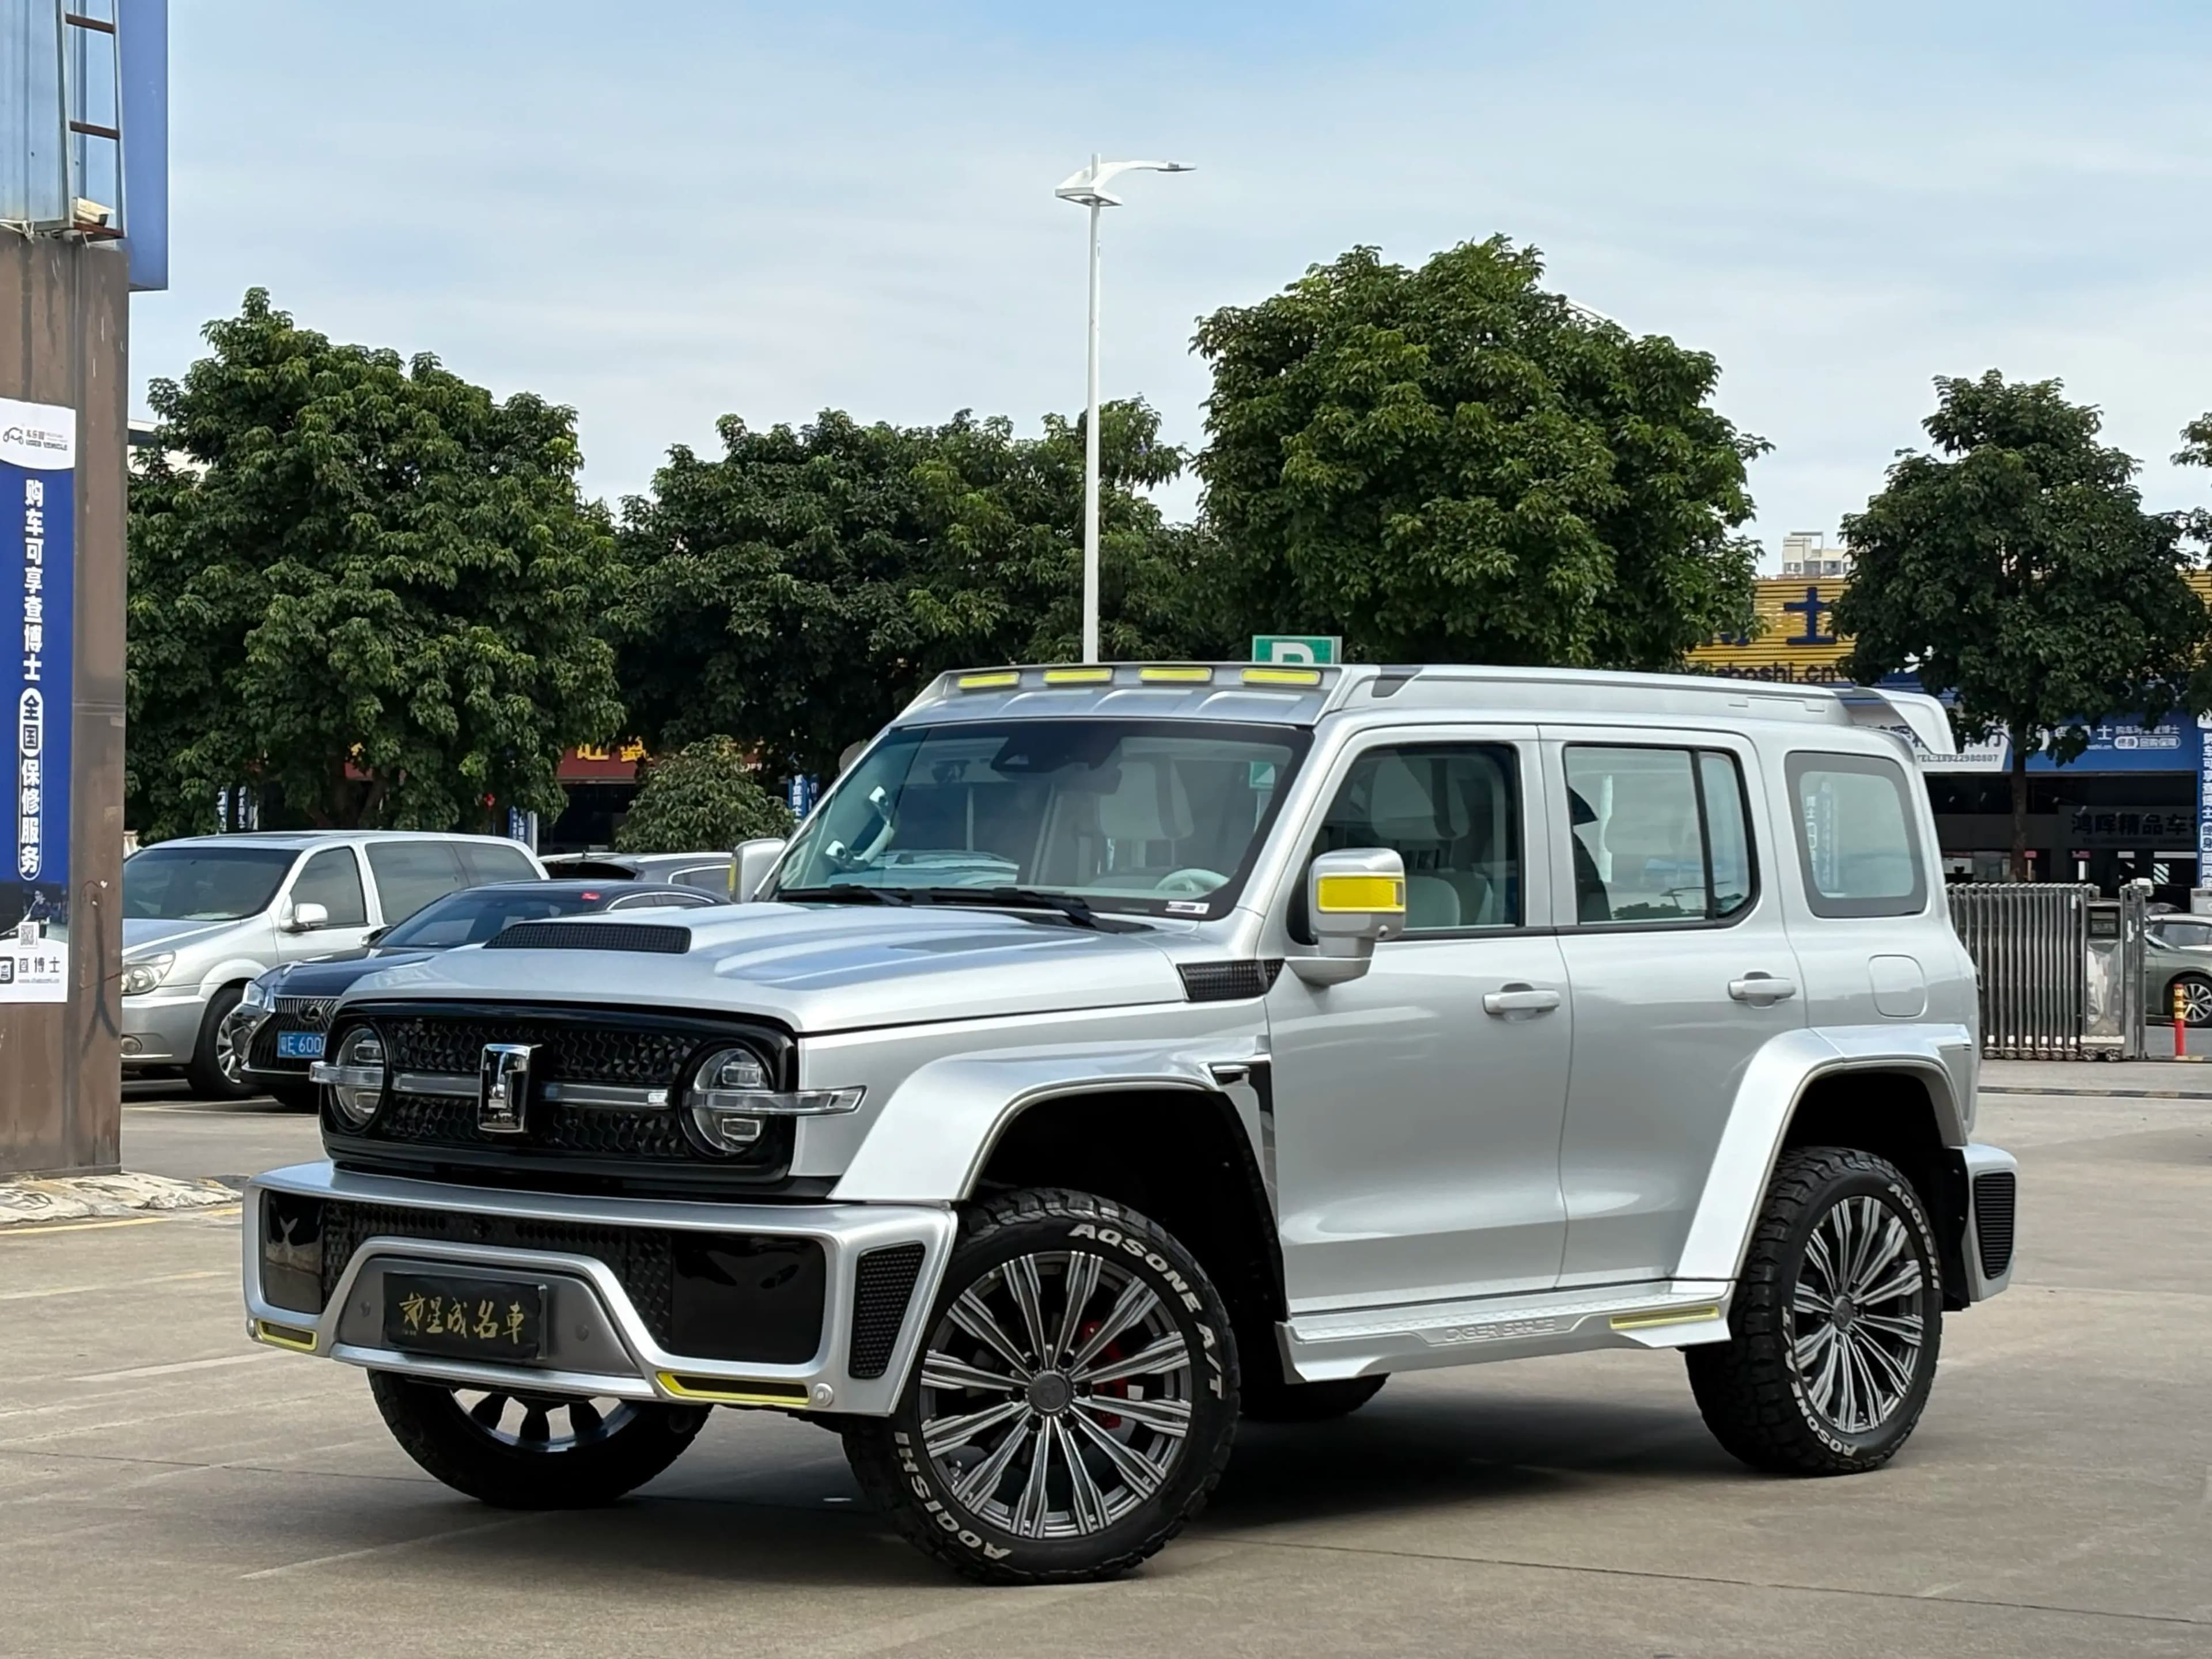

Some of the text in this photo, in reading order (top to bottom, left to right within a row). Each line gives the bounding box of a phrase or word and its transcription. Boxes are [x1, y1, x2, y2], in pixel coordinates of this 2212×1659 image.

[21, 479, 44, 874] 购车可享查博士 全国保修服务
[1068, 1222, 1202, 1314] AQSONE
[894, 1431, 1012, 1560] AOQISHI
